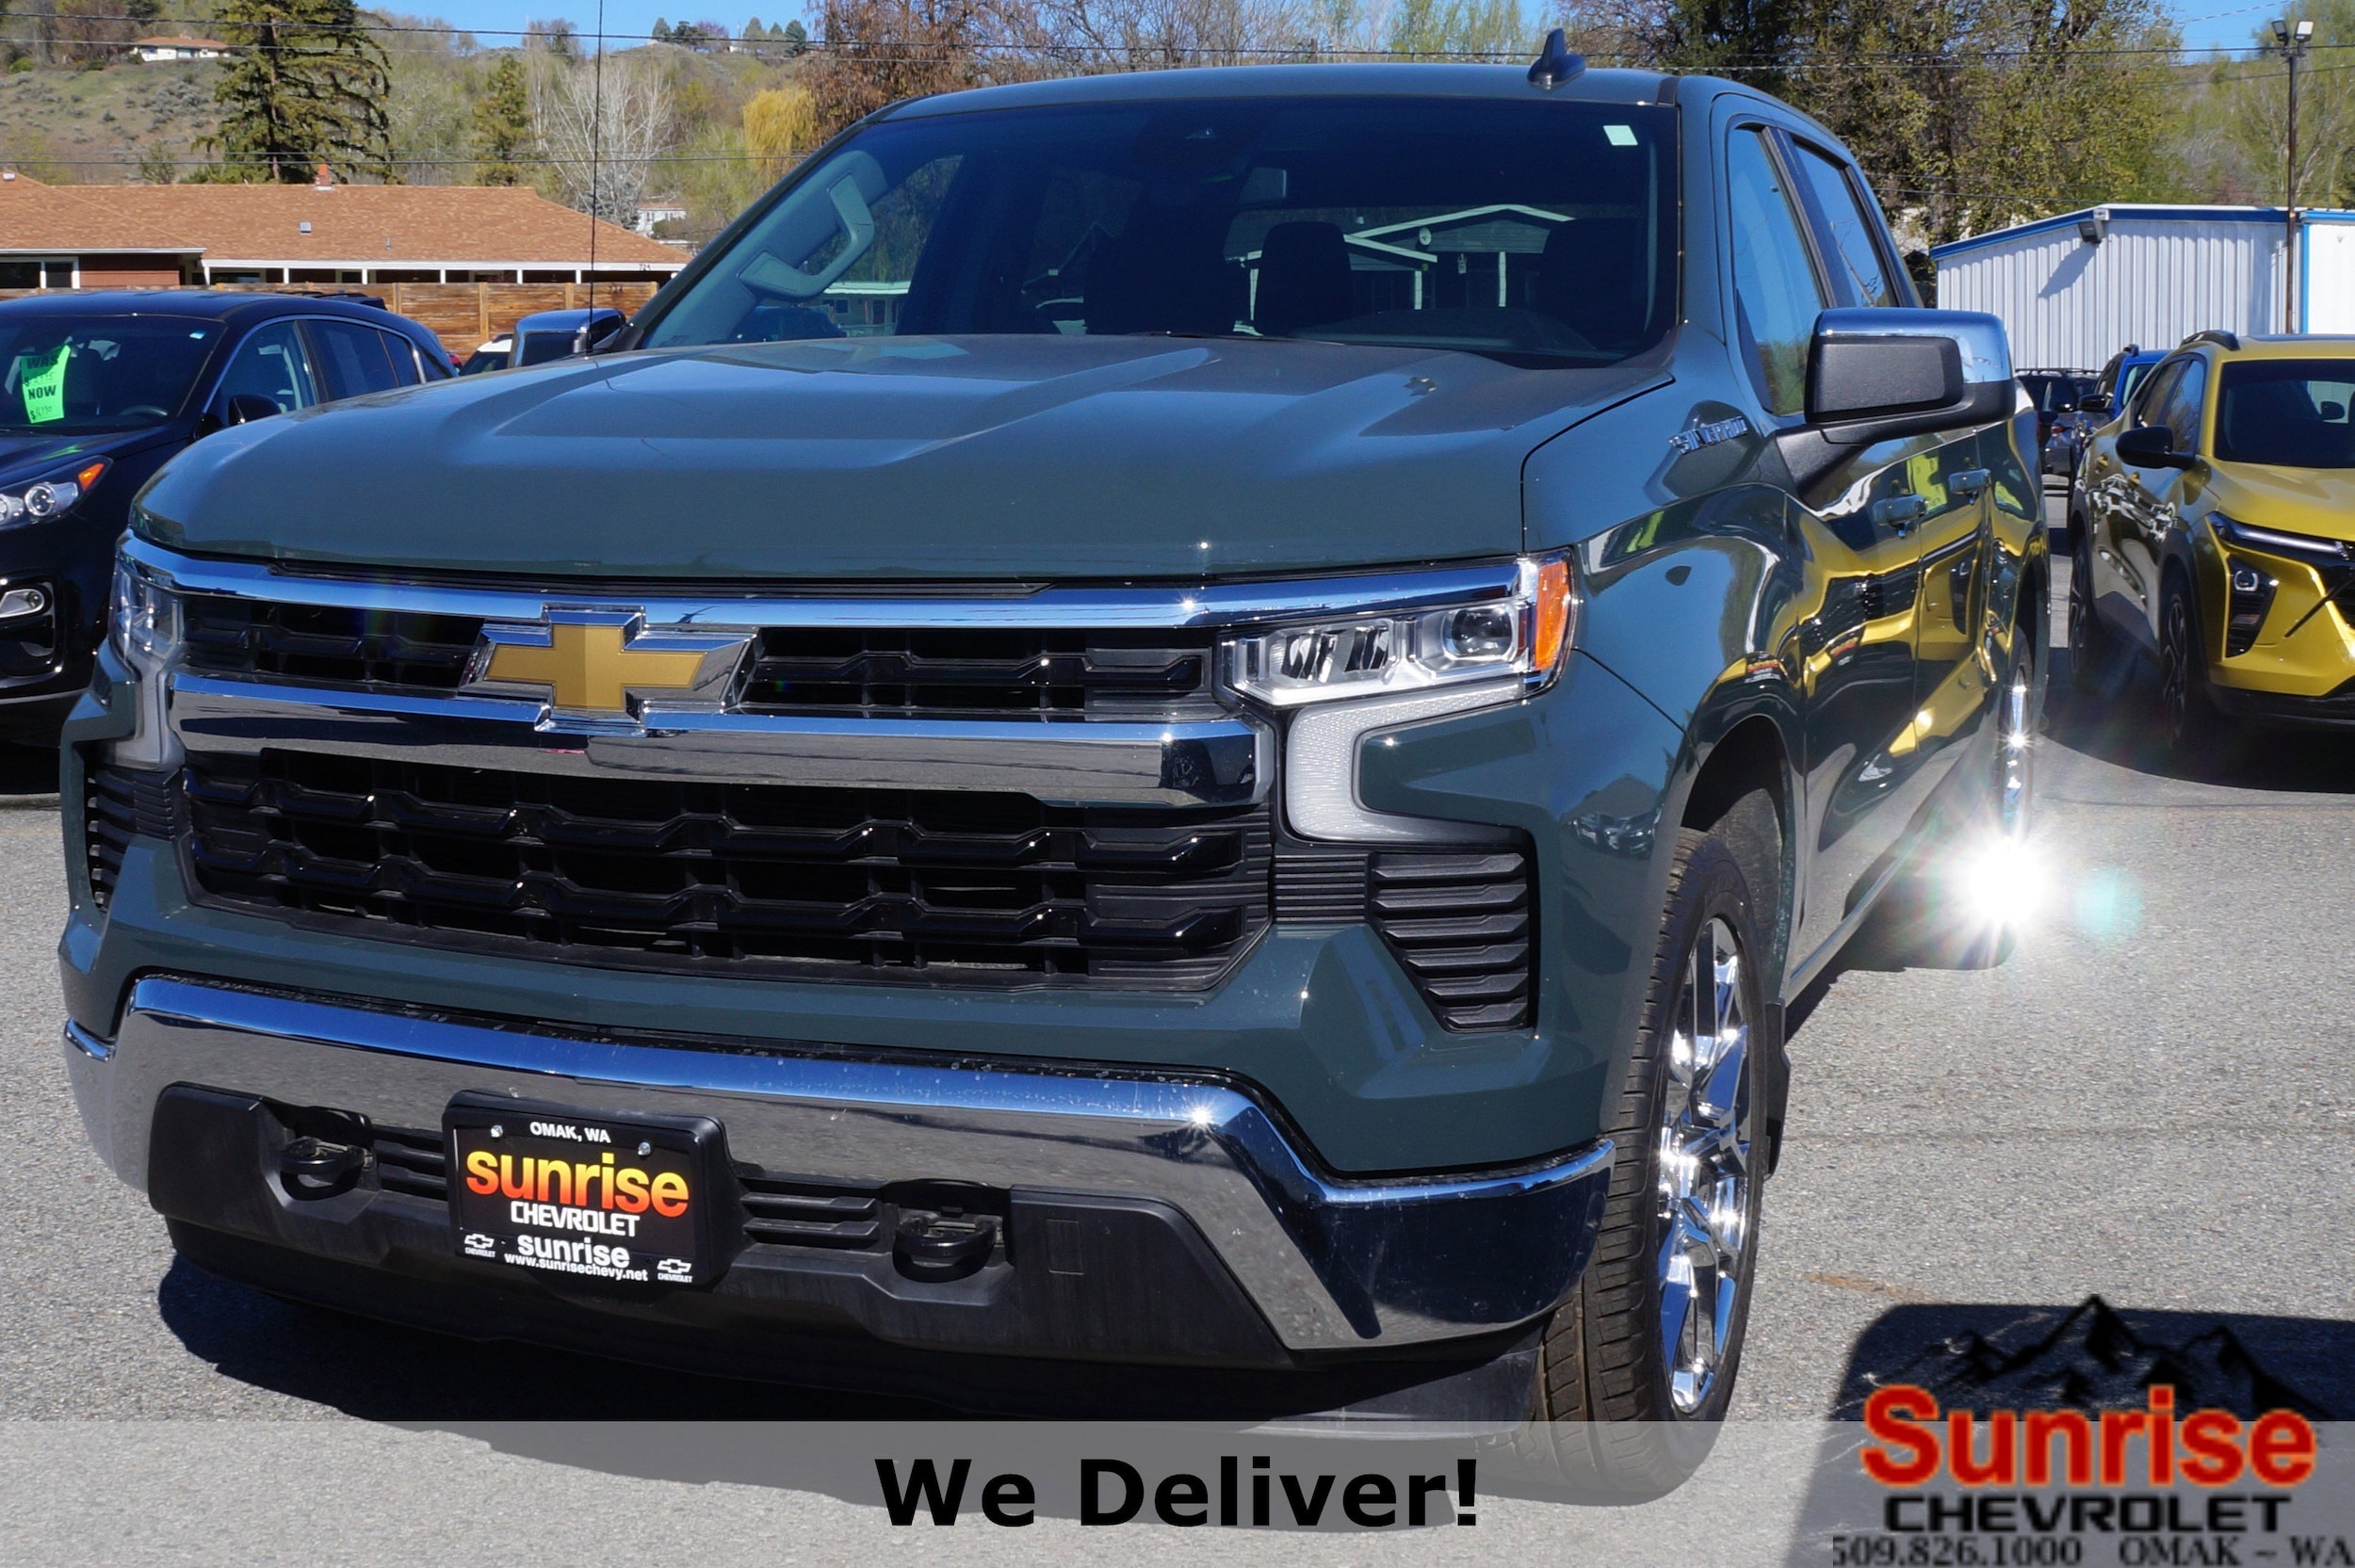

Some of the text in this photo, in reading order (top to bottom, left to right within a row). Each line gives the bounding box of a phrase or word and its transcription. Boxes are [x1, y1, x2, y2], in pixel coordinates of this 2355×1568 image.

[28, 385, 57, 400] NOW
[529, 1121, 611, 1144] OMAK, WA
[511, 1201, 640, 1237] CHEVROLET
[504, 1253, 648, 1282] www.sunrisechevy.net
